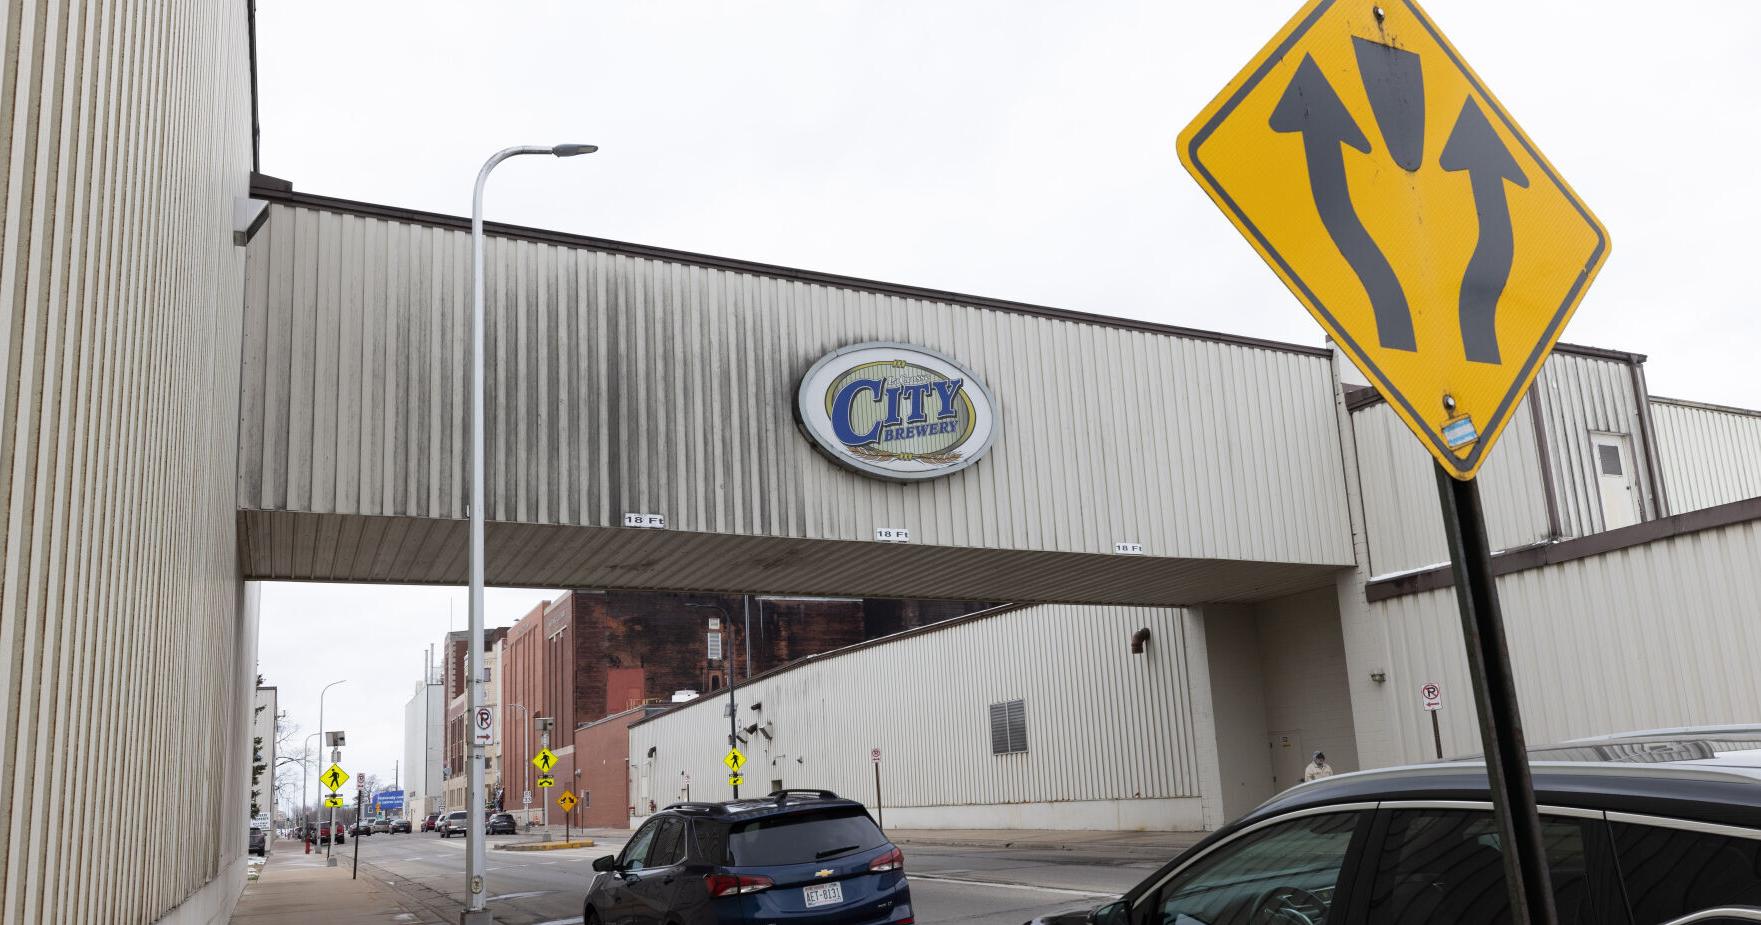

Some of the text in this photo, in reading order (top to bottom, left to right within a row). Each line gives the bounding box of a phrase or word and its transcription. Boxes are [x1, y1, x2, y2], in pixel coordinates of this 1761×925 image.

[832, 378, 963, 446] CITY
[884, 420, 959, 442] BREWERY
[624, 516, 665, 525] 18 Ft
[877, 530, 891, 538] 18
